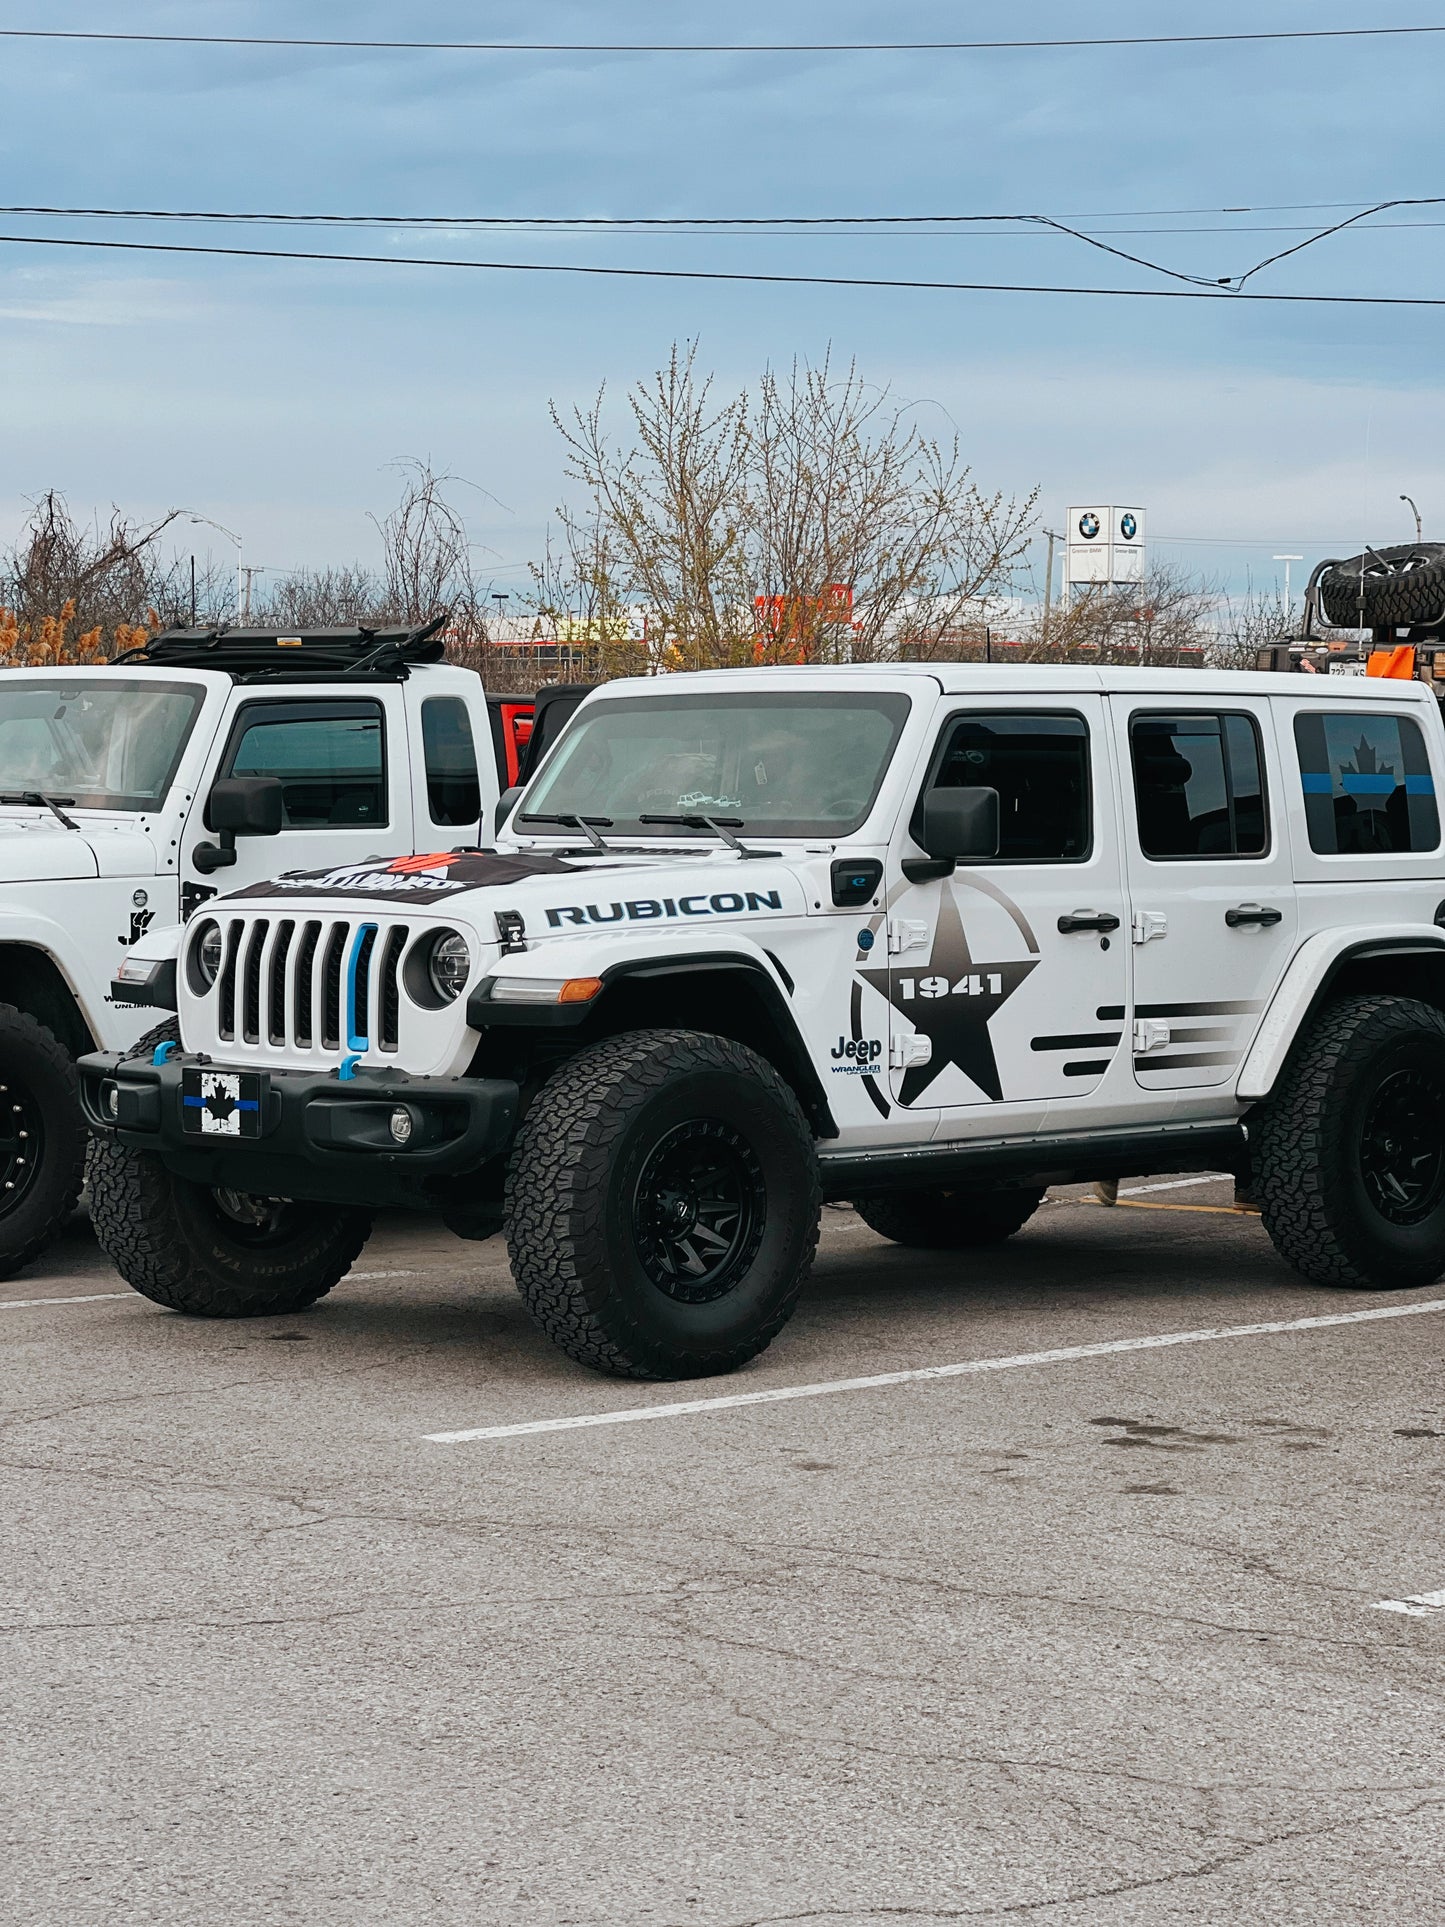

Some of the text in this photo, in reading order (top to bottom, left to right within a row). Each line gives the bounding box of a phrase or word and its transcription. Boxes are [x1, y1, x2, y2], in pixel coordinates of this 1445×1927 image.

[545, 890, 783, 928] RUBICON
[899, 972, 1002, 1000] 1941
[831, 1036, 882, 1061] Jeep
[831, 1065, 881, 1073] WRANGLER
